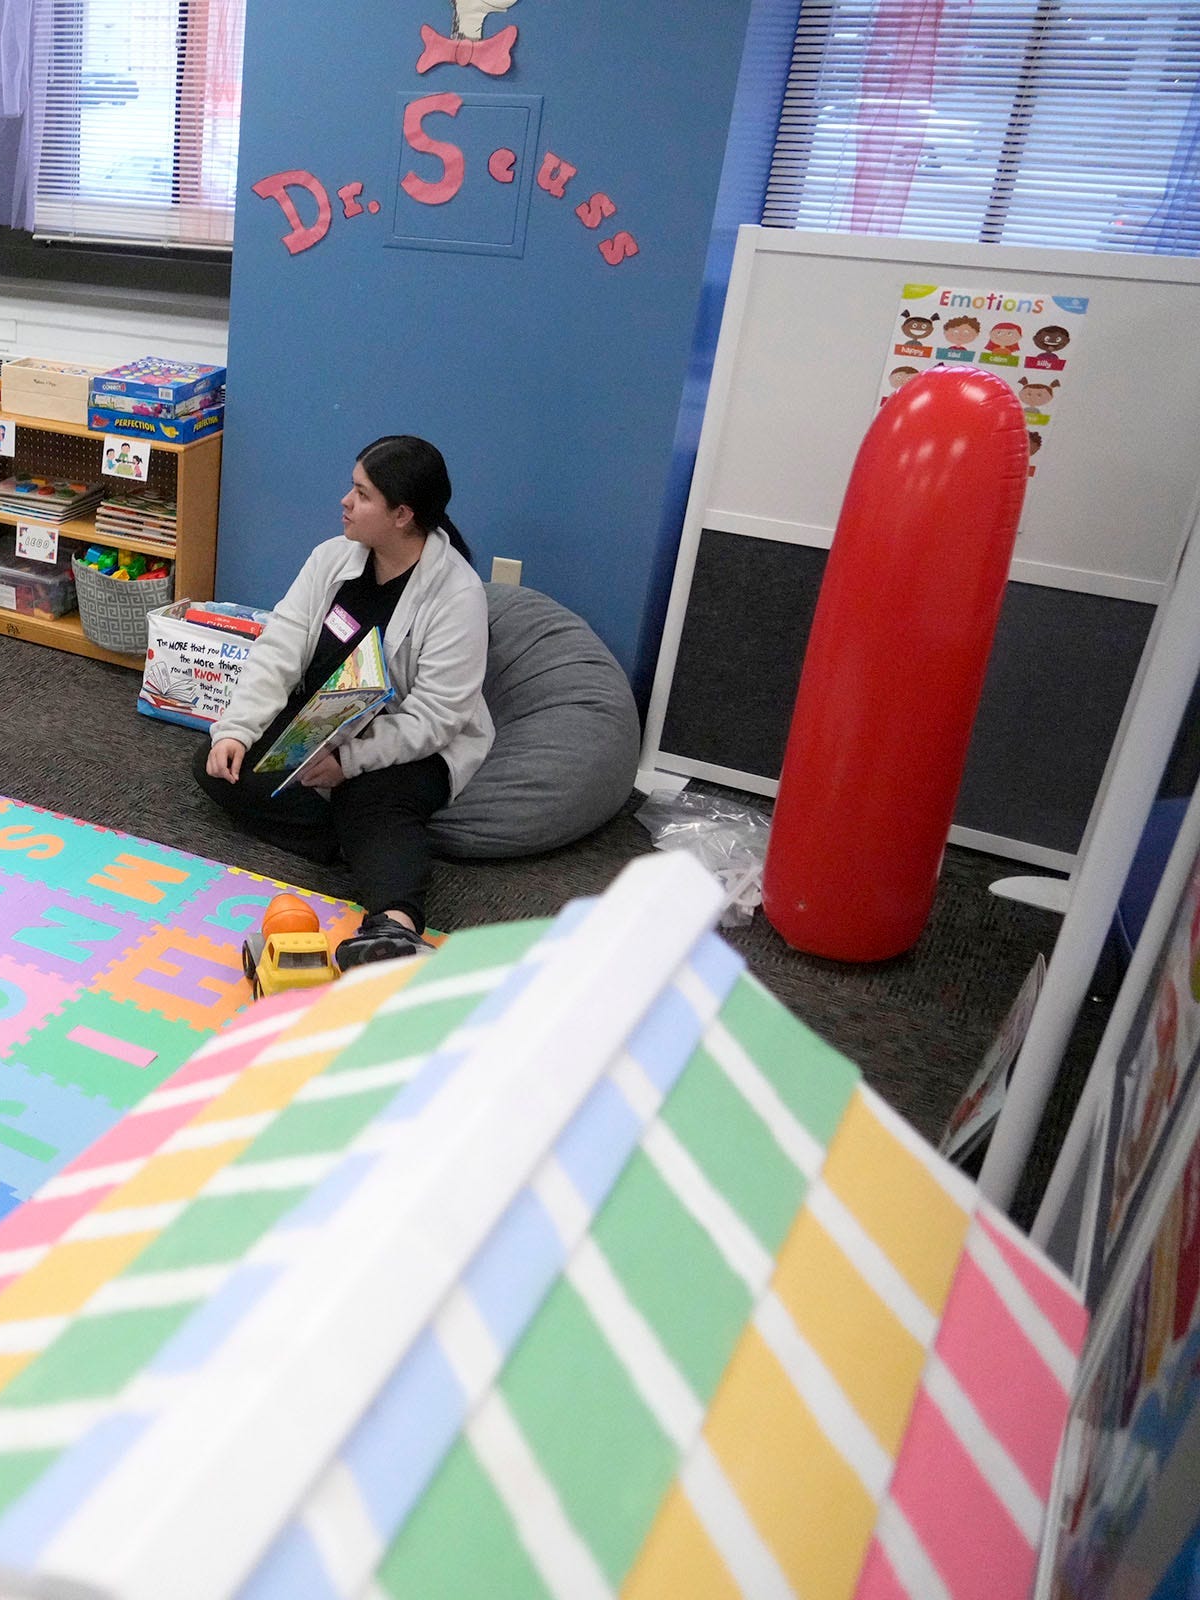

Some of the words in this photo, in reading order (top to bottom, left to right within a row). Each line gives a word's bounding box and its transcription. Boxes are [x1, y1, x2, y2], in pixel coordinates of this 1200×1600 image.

[252, 170, 381, 255] Dr.
[401, 92, 640, 266] Seuss
[939, 291, 1045, 314] Emotions
[900, 346, 925, 357] happy
[1036, 360, 1052, 369] silly
[114, 418, 156, 432] PERFECTION
[193, 416, 219, 432] PERFECTION
[25, 537, 50, 549] LEGO
[157, 639, 168, 647] The
[169, 641, 188, 651] MORE
[191, 643, 206, 654] that
[207, 647, 220, 655] you
[180, 654, 191, 664] the
[218, 660, 243, 675] things
[170, 666, 181, 674] you
[194, 668, 222, 684] KNOW.
[200, 682, 213, 691] that
[134, 946, 246, 1009] H
